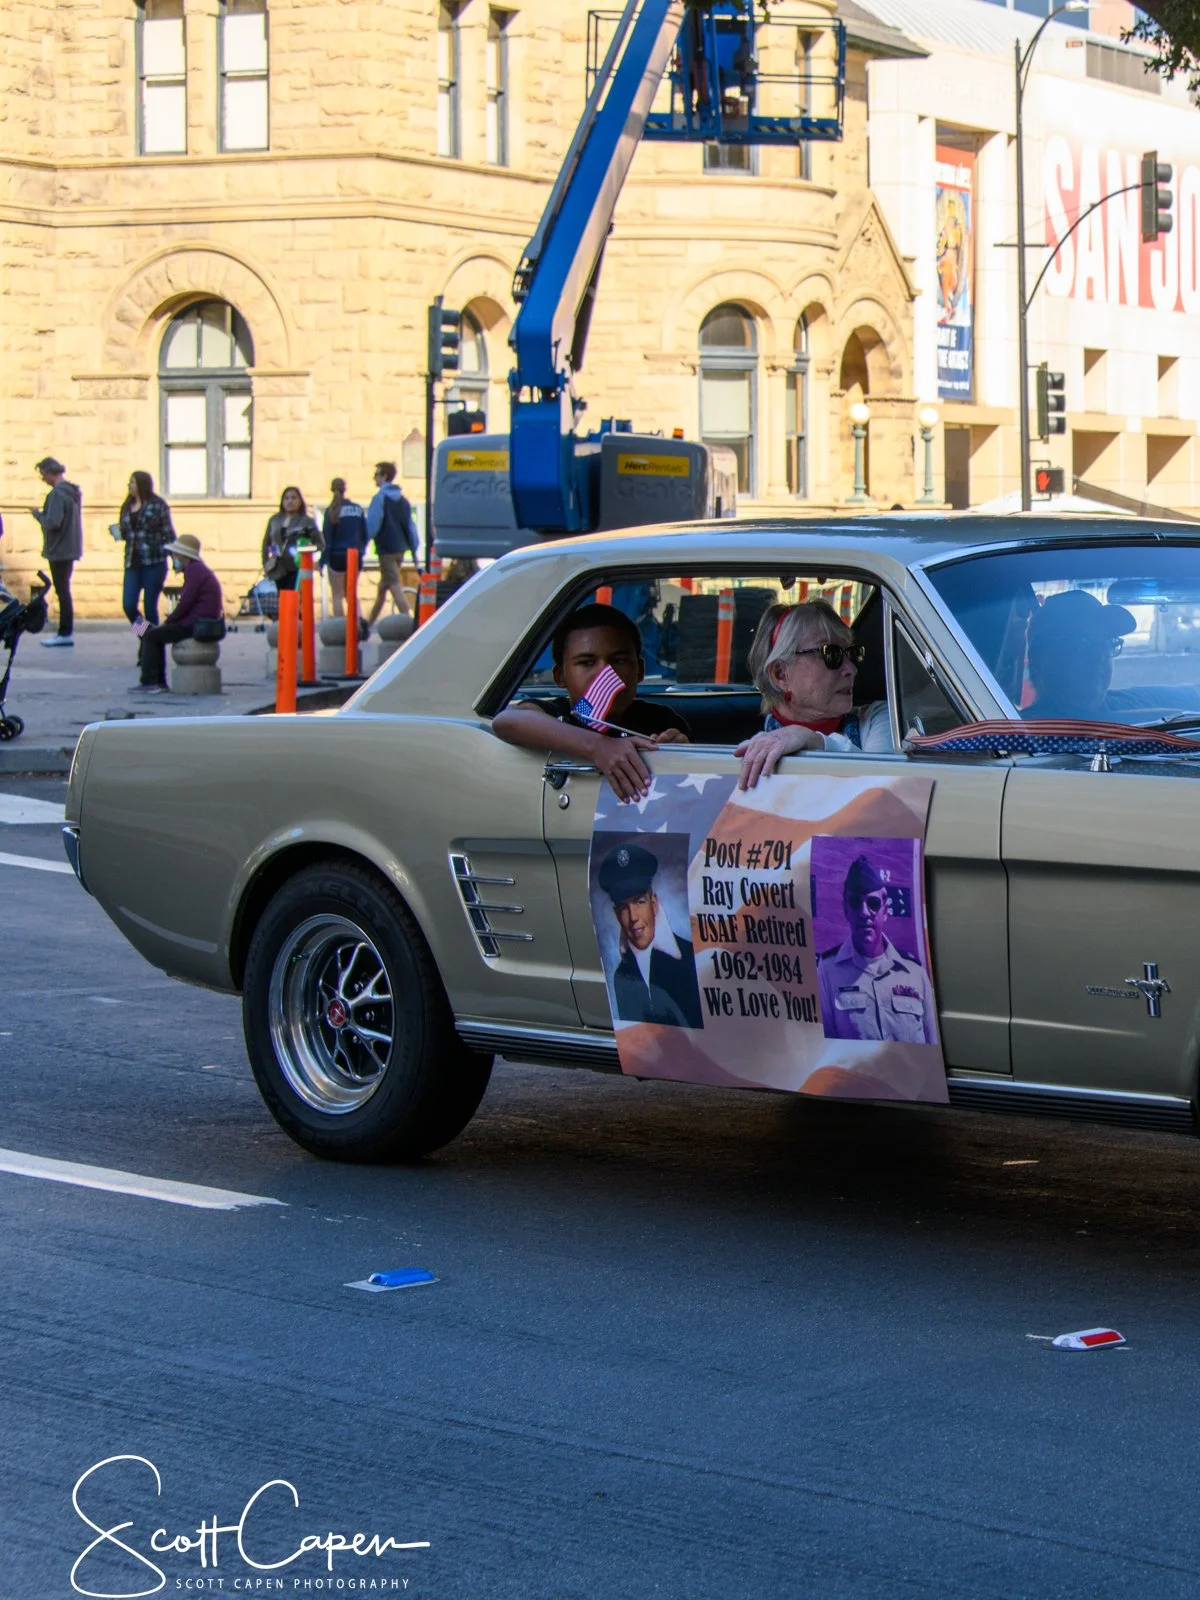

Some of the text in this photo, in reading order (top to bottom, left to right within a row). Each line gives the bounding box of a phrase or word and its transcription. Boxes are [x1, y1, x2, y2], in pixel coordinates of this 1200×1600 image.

[1043, 135, 1140, 306] SAN
[704, 838, 793, 870] Post #791
[702, 876, 796, 910] Ray Covert
[697, 913, 807, 947] USAF Retired
[711, 950, 803, 985] 1962-1984
[703, 987, 819, 1023] We Love You!
